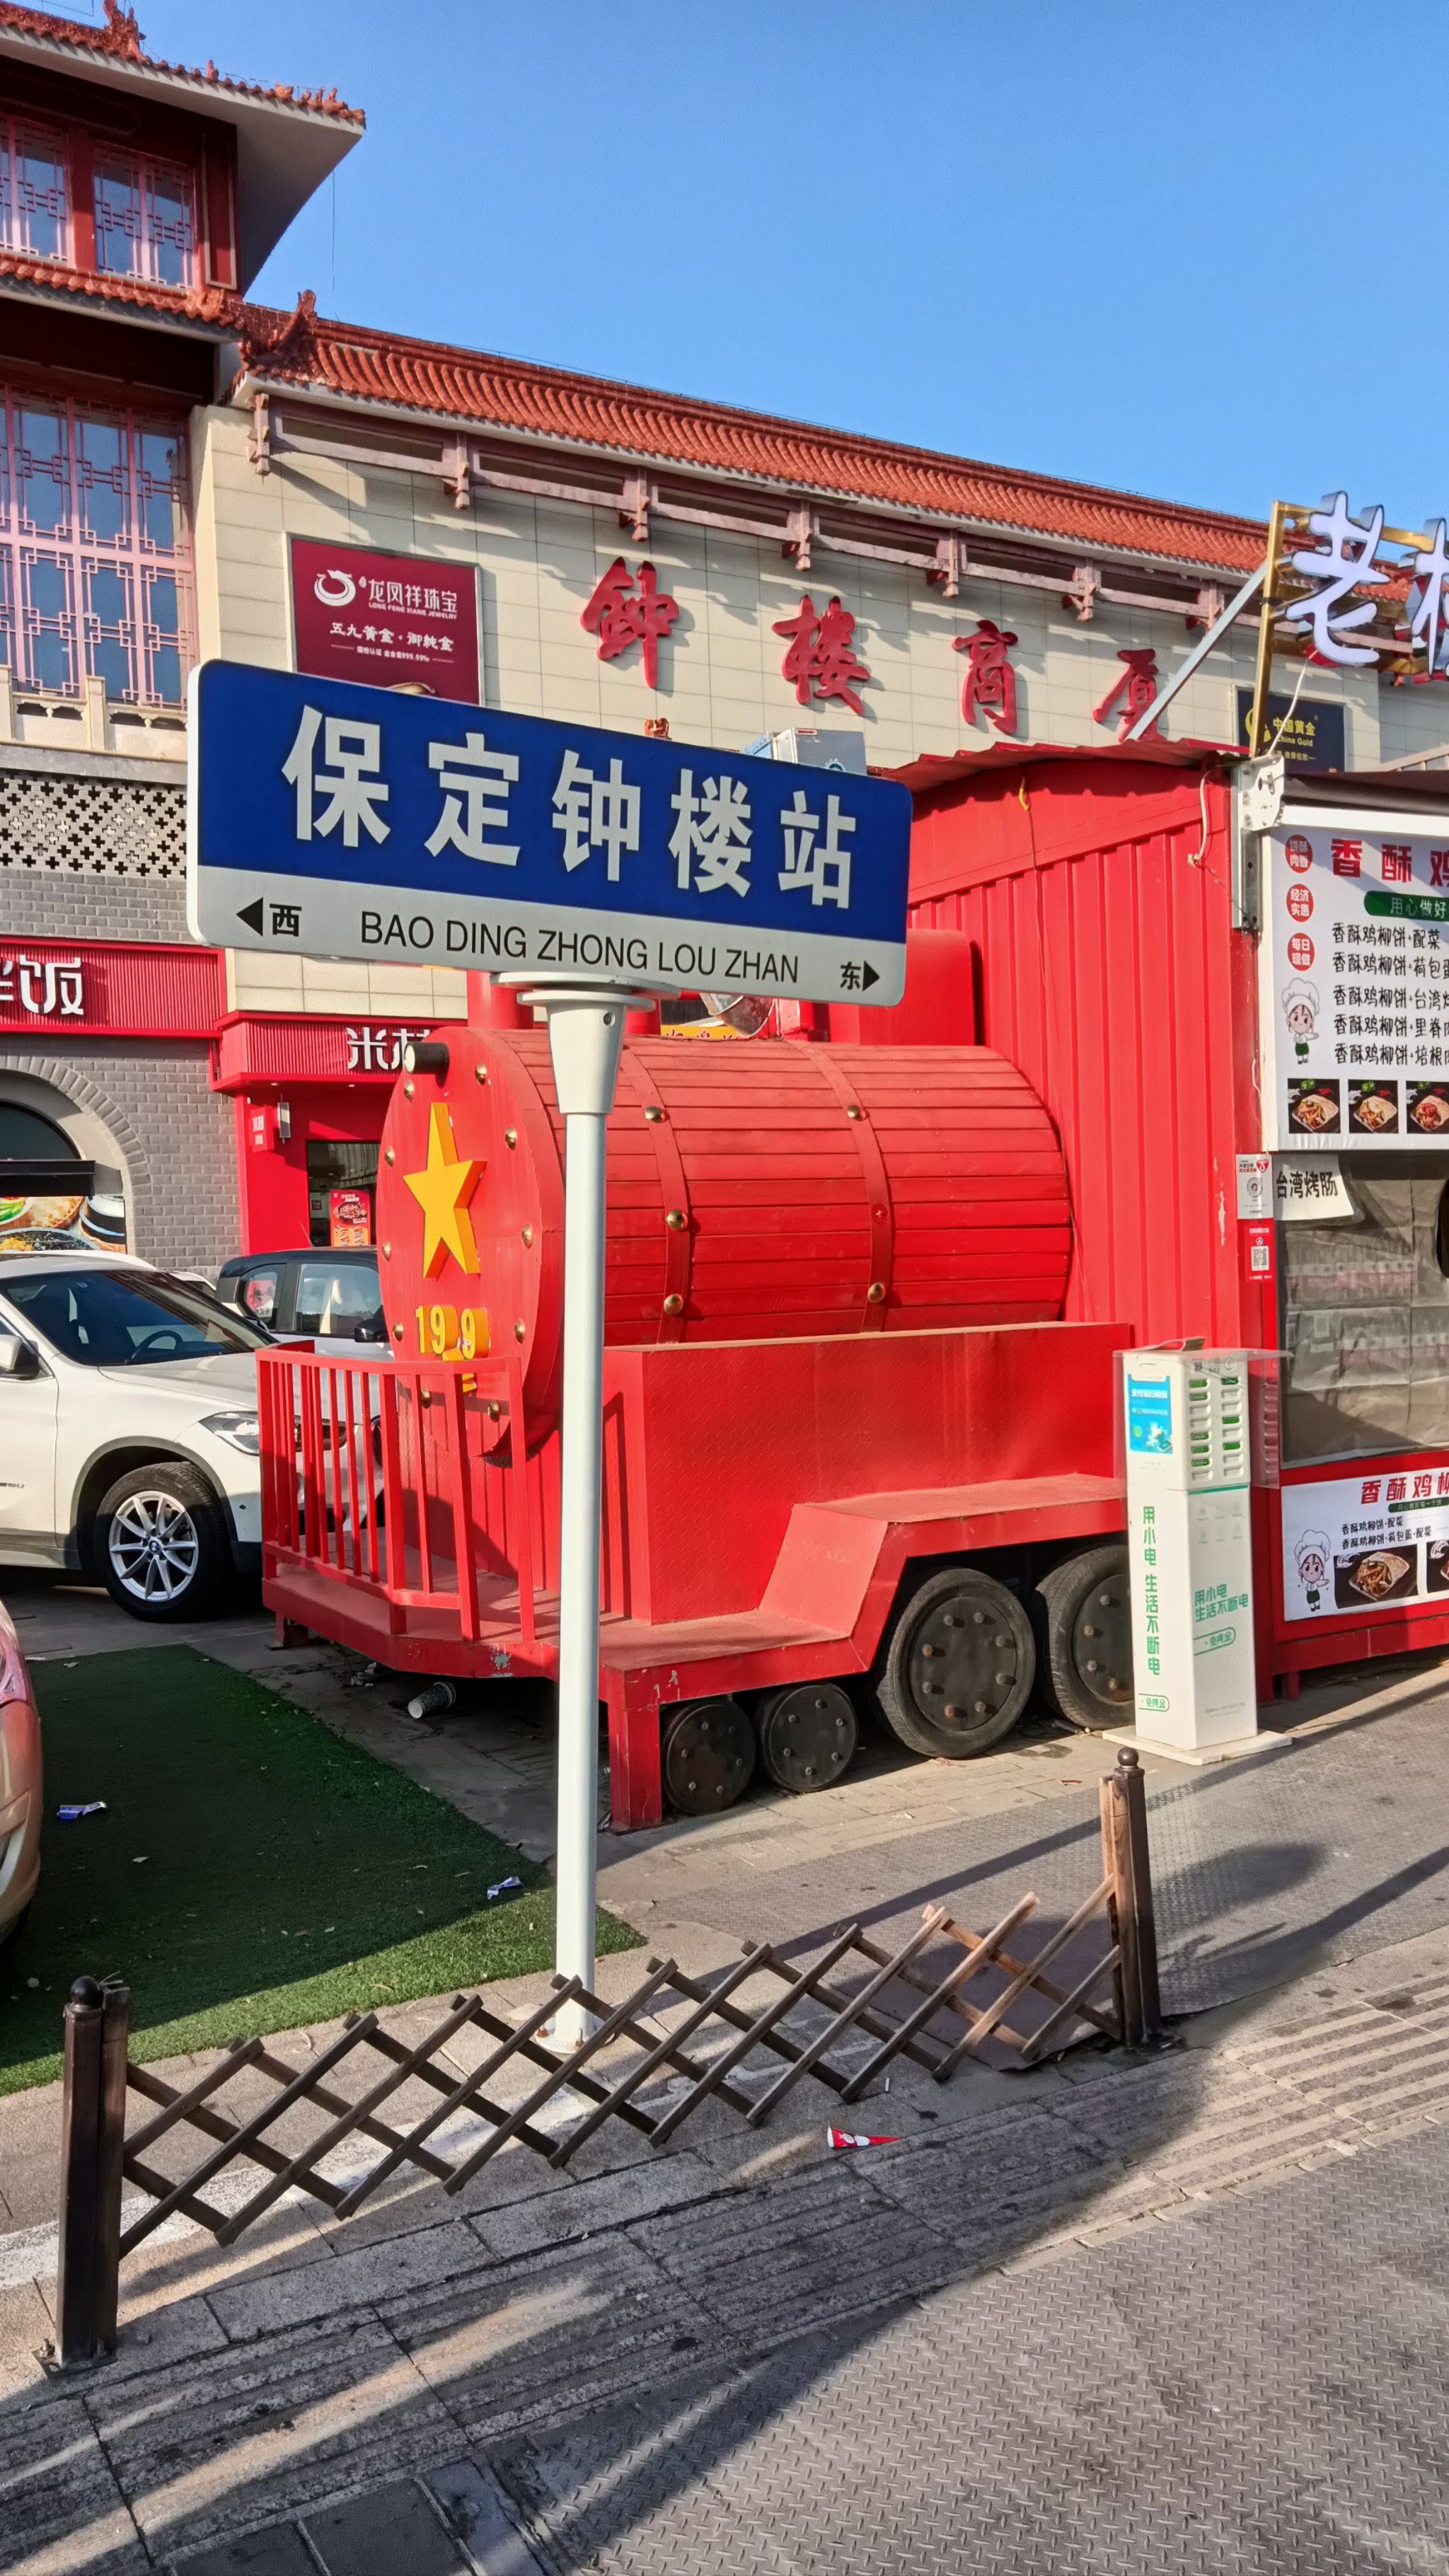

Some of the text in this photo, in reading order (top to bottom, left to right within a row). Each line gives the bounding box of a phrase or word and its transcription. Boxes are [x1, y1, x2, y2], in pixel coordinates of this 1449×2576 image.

[368, 579, 457, 613] 龙凤祥珠宝
[387, 604, 405, 613] FENG
[407, 608, 427, 616] XIANG
[428, 611, 458, 620] JEWELRY
[1273, 717, 1315, 736] 中国黄金
[1297, 737, 1313, 746] Gold
[282, 704, 856, 908] 保定钟楼站
[1290, 889, 1310, 902] 经济
[270, 903, 302, 937] 西
[1290, 903, 1310, 917] 实惠
[361, 911, 798, 983] BAO DING ZHONG LOU ZHAN
[1291, 937, 1310, 952] 每日
[1292, 952, 1310, 966] 现做
[840, 961, 860, 990] 东
[1276, 1171, 1338, 1199] 台湾烤肠
[1194, 1583, 1227, 1607] 用小电
[1194, 1593, 1248, 1622] 生活不断电
